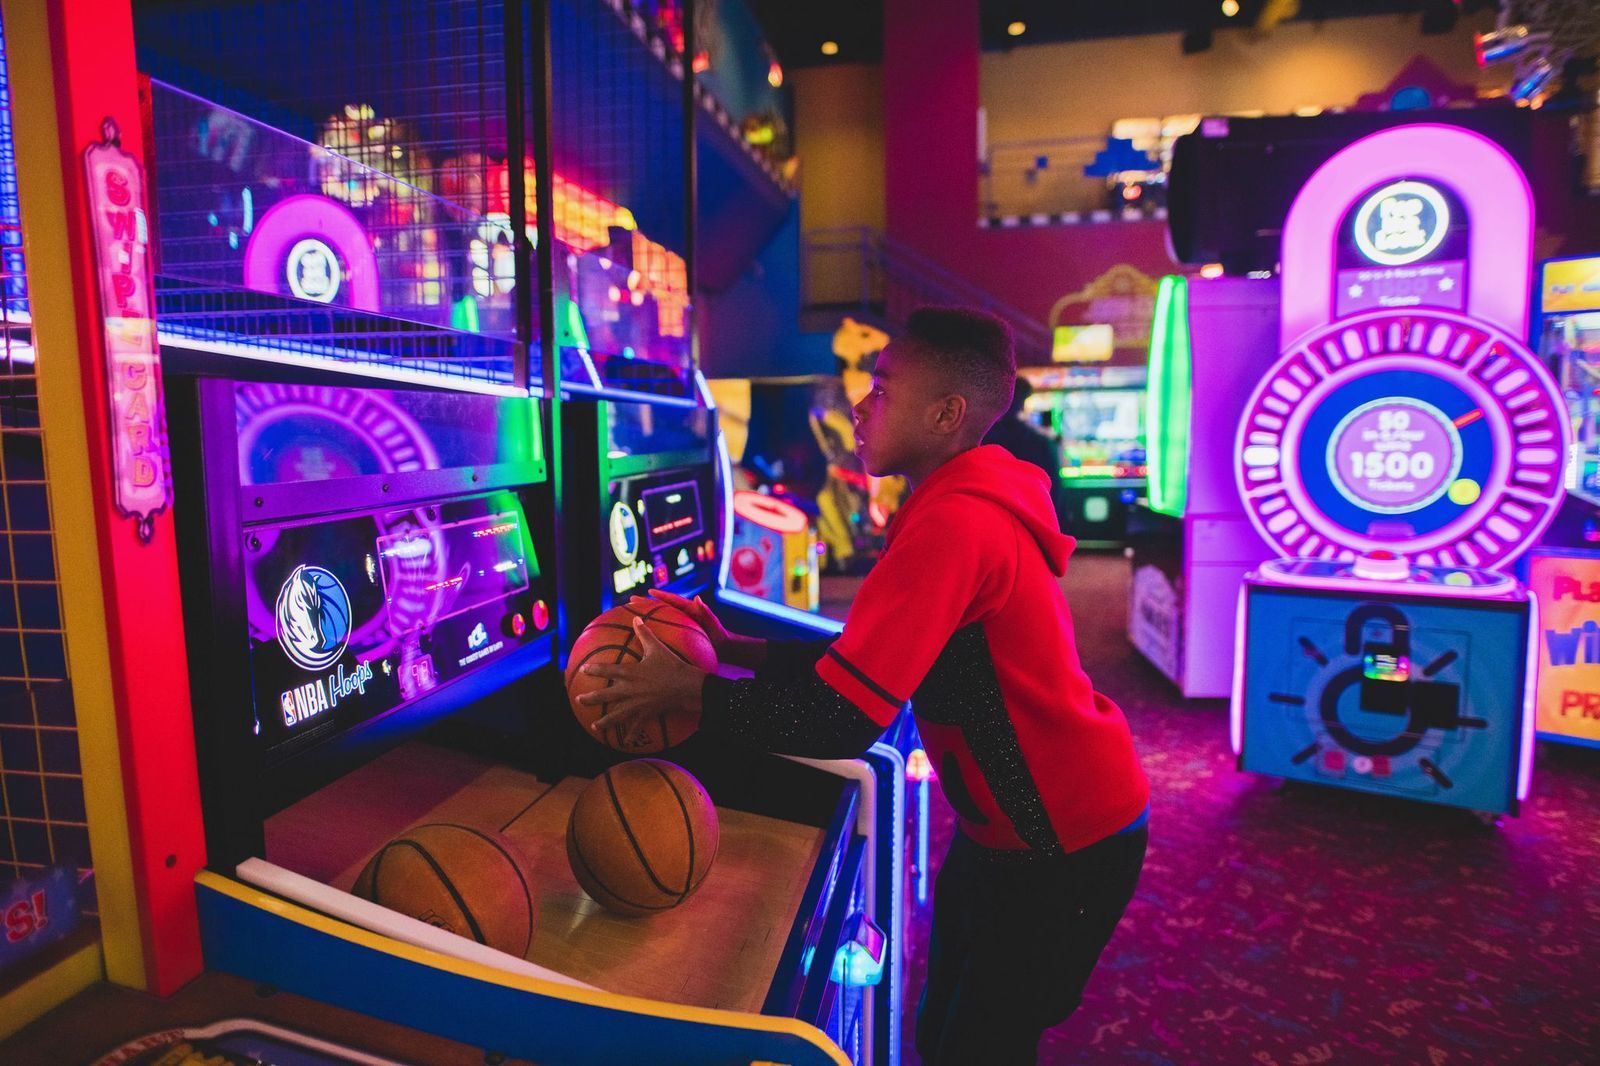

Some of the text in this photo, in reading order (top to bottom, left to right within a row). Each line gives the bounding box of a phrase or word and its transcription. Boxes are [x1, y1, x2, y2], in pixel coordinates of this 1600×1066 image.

[121, 361, 160, 488] CARD
[1350, 451, 1435, 480] 1500
[293, 659, 373, 721] NBA Hoops
[3, 888, 48, 944] S!
